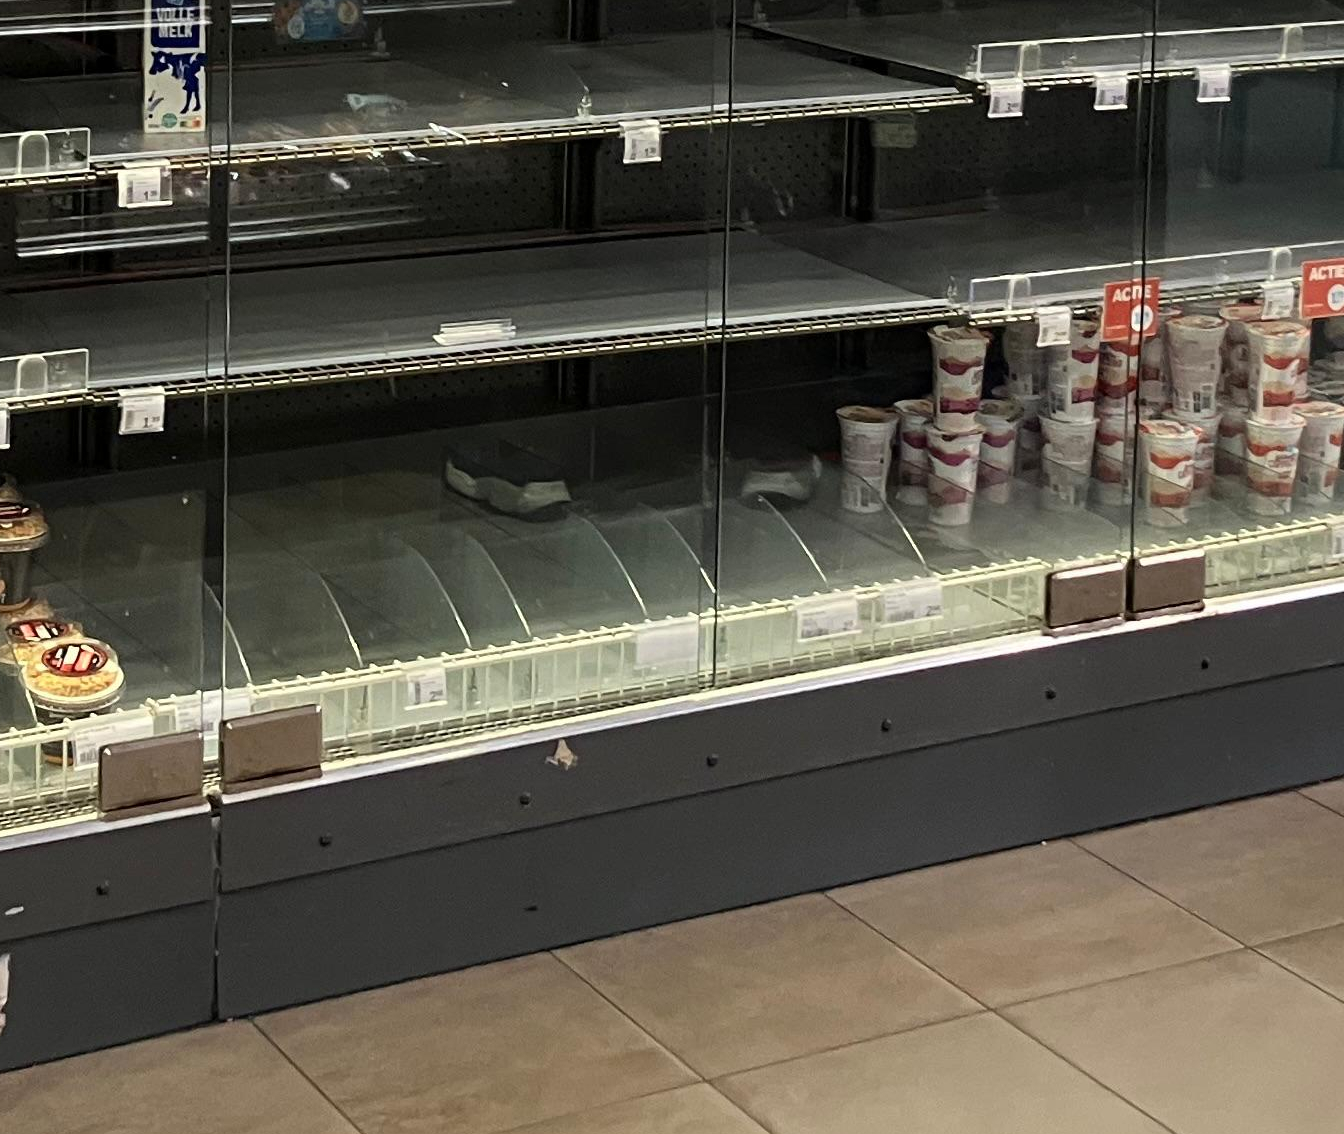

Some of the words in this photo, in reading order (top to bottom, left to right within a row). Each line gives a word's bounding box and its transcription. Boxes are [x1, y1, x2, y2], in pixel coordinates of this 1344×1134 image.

[156, 6, 196, 23] VOLLE
[158, 23, 193, 39] MELK
[1113, 285, 1152, 303] ACTIE
